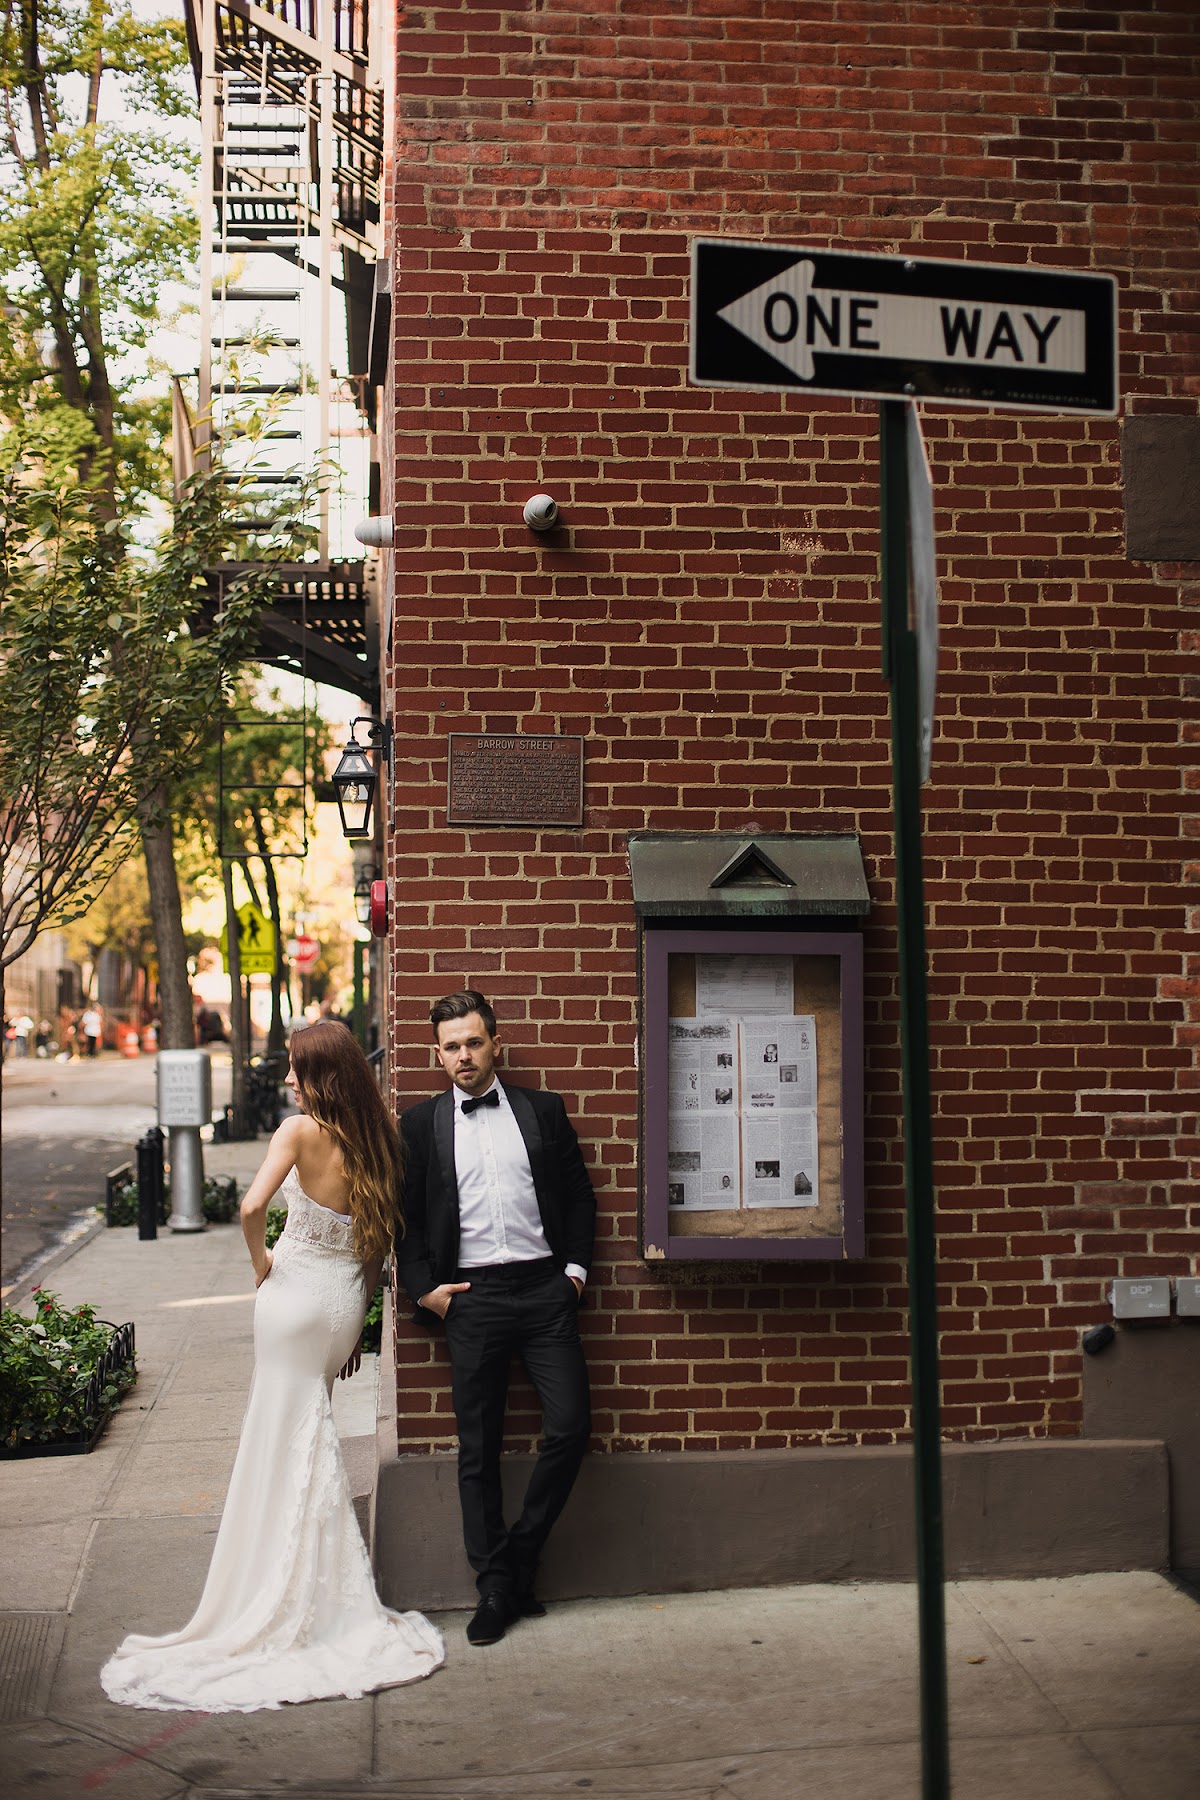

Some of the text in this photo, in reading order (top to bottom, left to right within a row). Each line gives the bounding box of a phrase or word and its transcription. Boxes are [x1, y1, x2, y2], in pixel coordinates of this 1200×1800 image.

[764, 291, 1061, 364] ONE WAY
[477, 739, 555, 751] BARROW STREET
[1130, 1285, 1153, 1295] DEP
